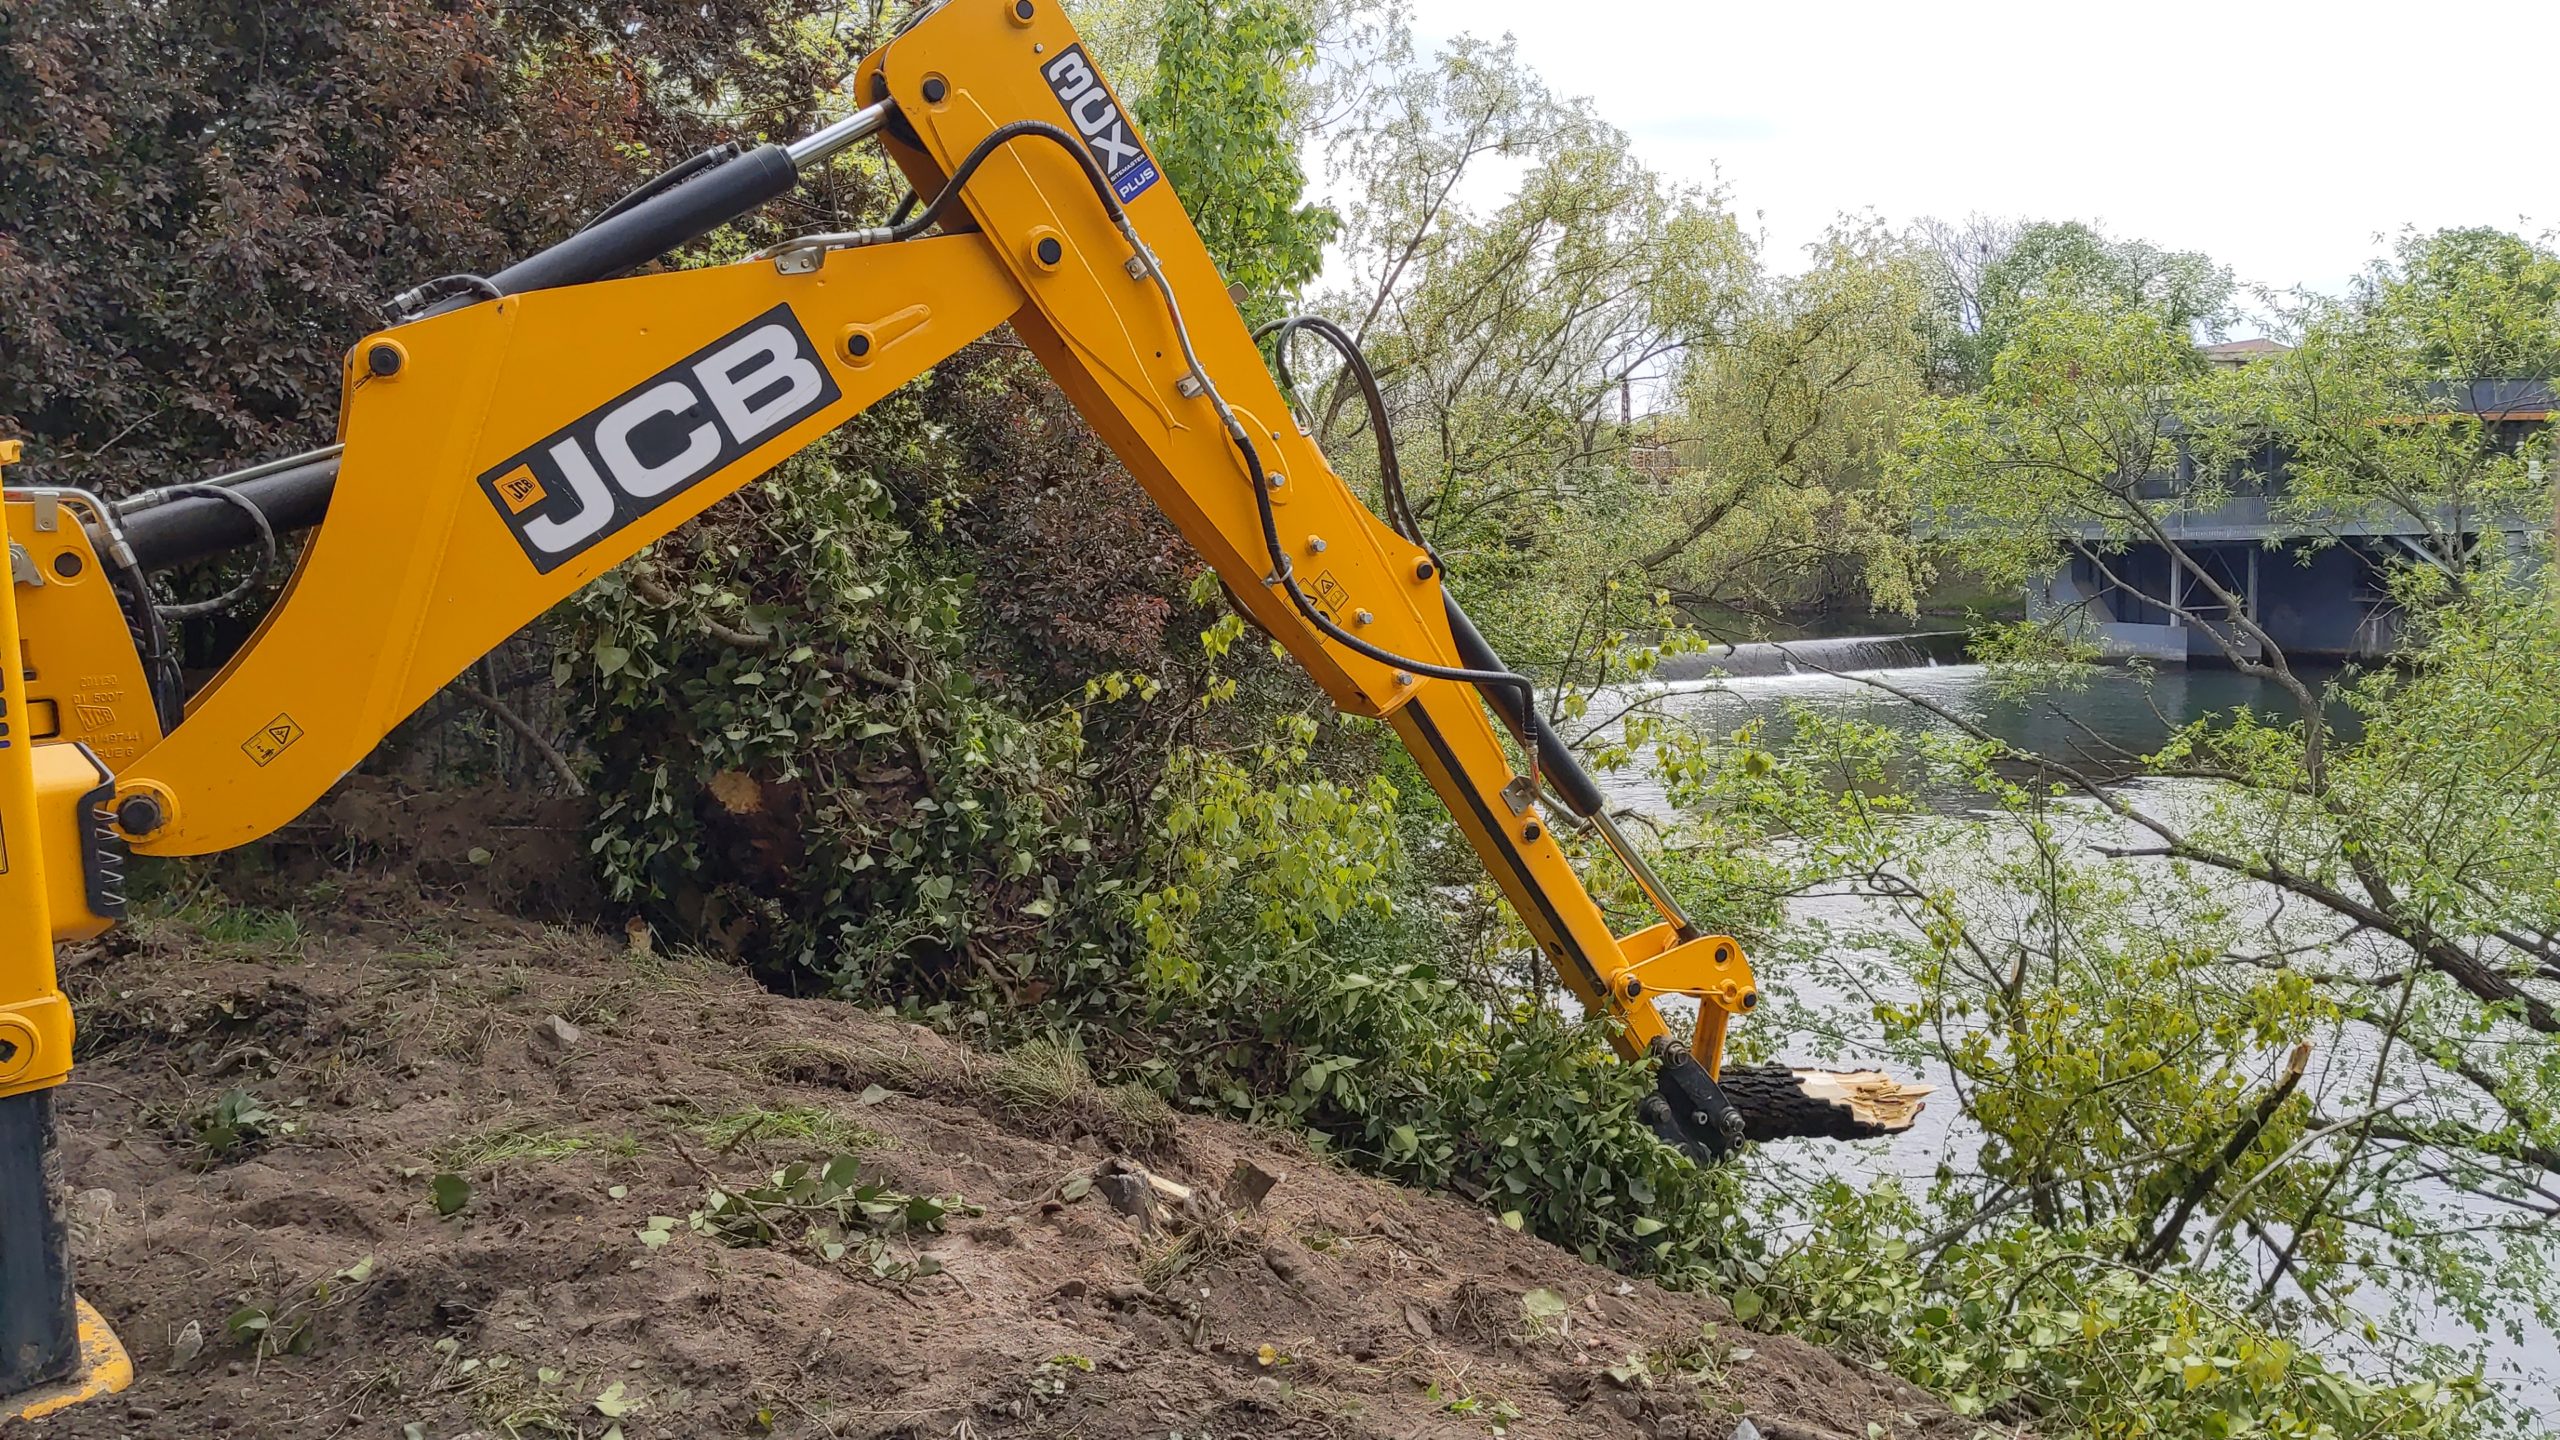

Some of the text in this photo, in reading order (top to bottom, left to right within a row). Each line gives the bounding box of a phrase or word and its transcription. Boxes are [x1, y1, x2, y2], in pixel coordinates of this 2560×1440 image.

[1049, 52, 1141, 175] 3CX
[1110, 153, 1146, 182] SITEMASTER
[1119, 167, 1154, 198] PLUS
[522, 324, 822, 553] JCB
[507, 478, 534, 500] JCB
[82, 707, 114, 728] JCB
